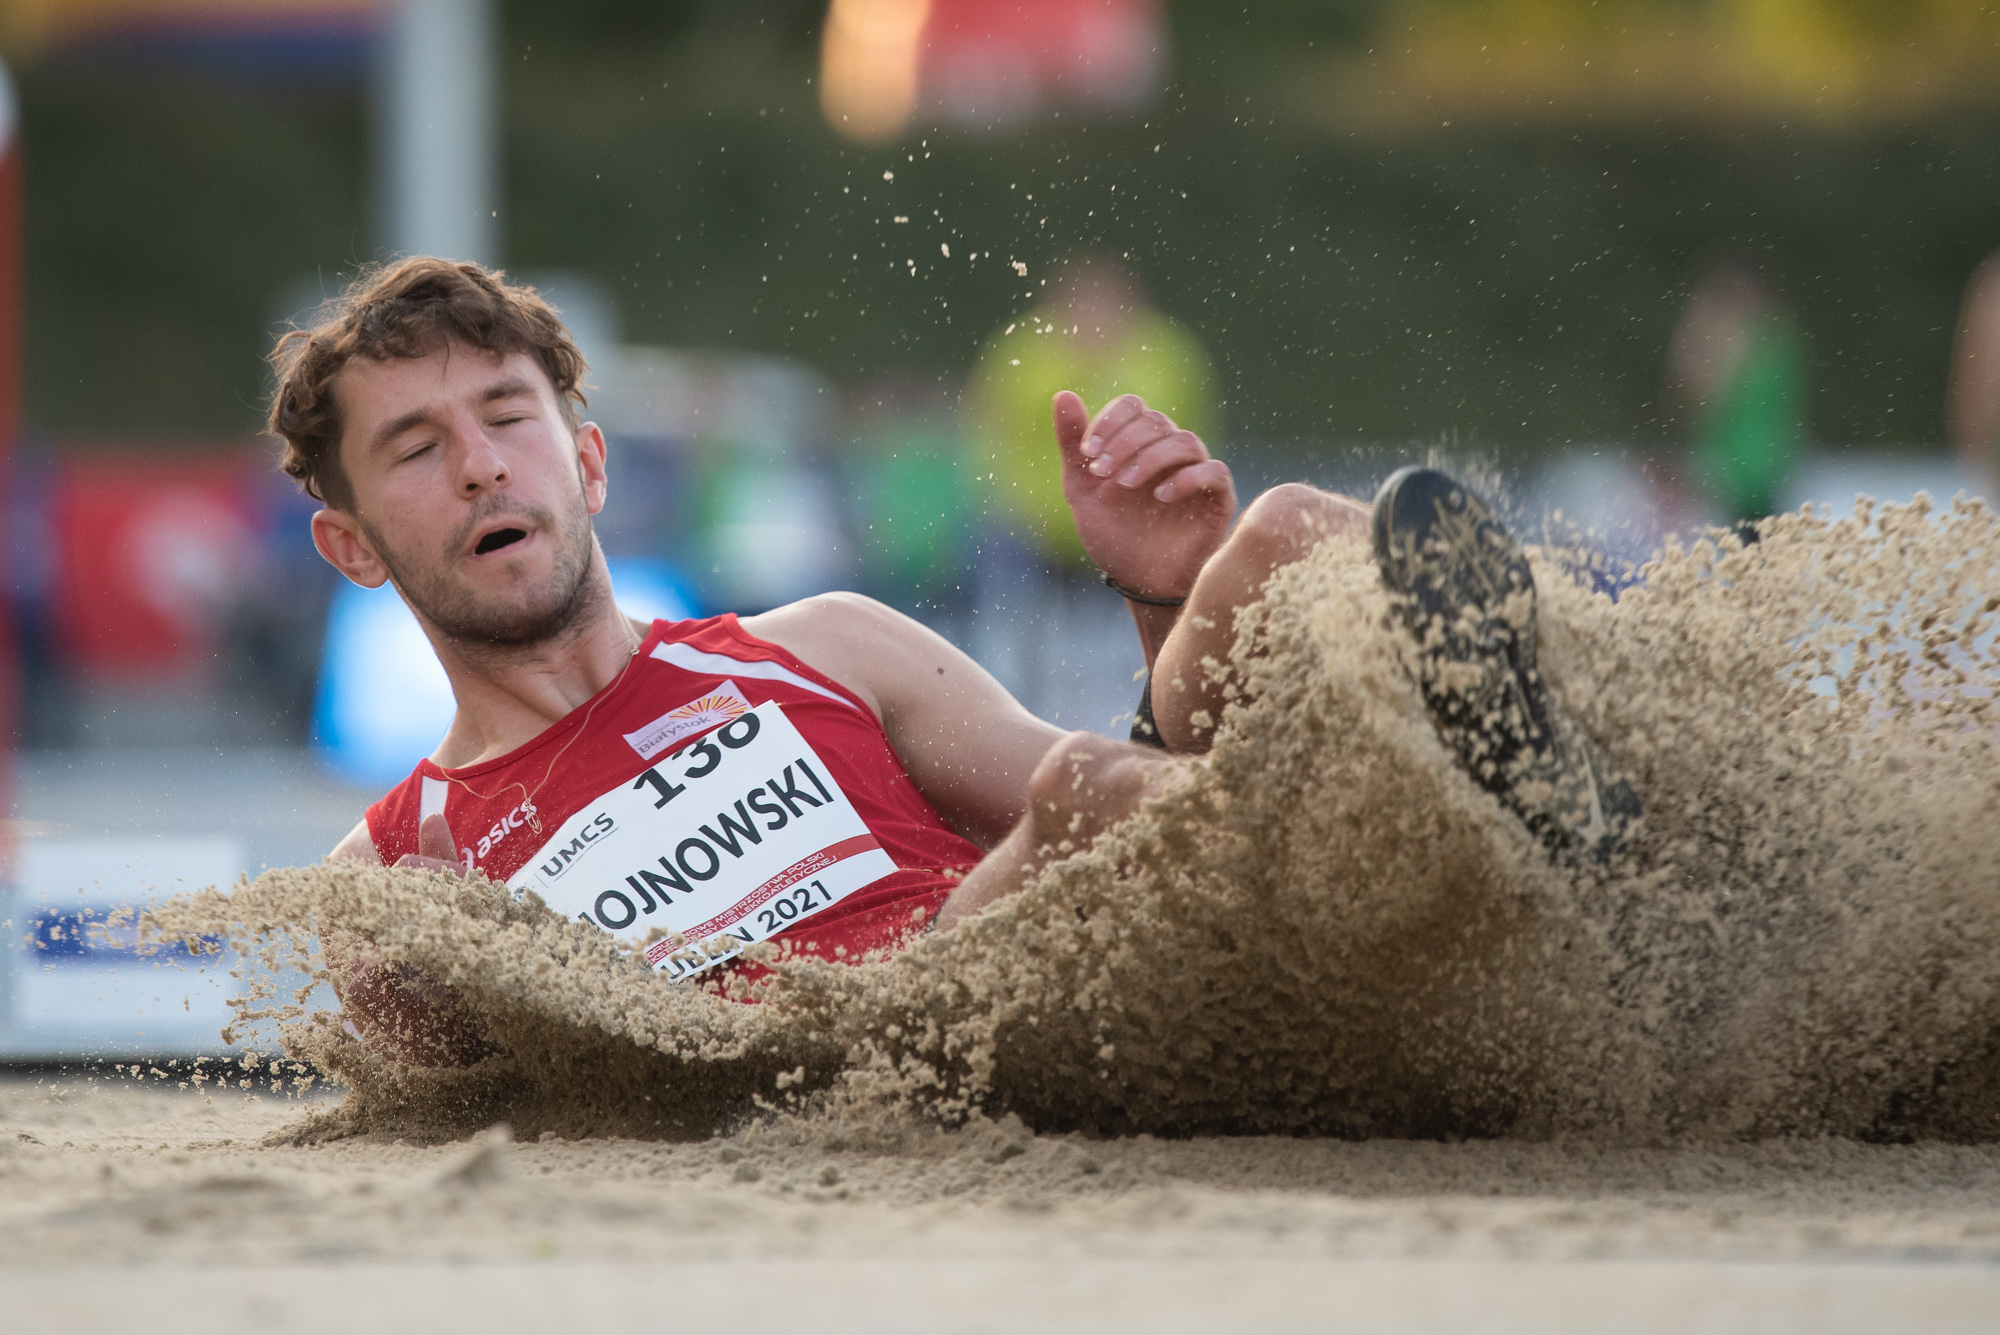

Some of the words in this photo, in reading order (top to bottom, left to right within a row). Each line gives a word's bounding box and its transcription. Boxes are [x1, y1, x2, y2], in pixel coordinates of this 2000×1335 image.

[632, 711, 761, 811] 130
[638, 715, 733, 754] Białystok
[476, 804, 538, 859] asics
[540, 811, 615, 877] UMCS
[577, 757, 835, 931] OJNOWSKI
[651, 925, 719, 965] KSTRKASY
[719, 913, 740, 929] LIGI
[739, 854, 838, 918] LEKKOATLETYCZNEJ
[714, 872, 788, 924] MISTRZOSTWA
[786, 851, 825, 876] POLSKI
[756, 879, 833, 933] 2021
